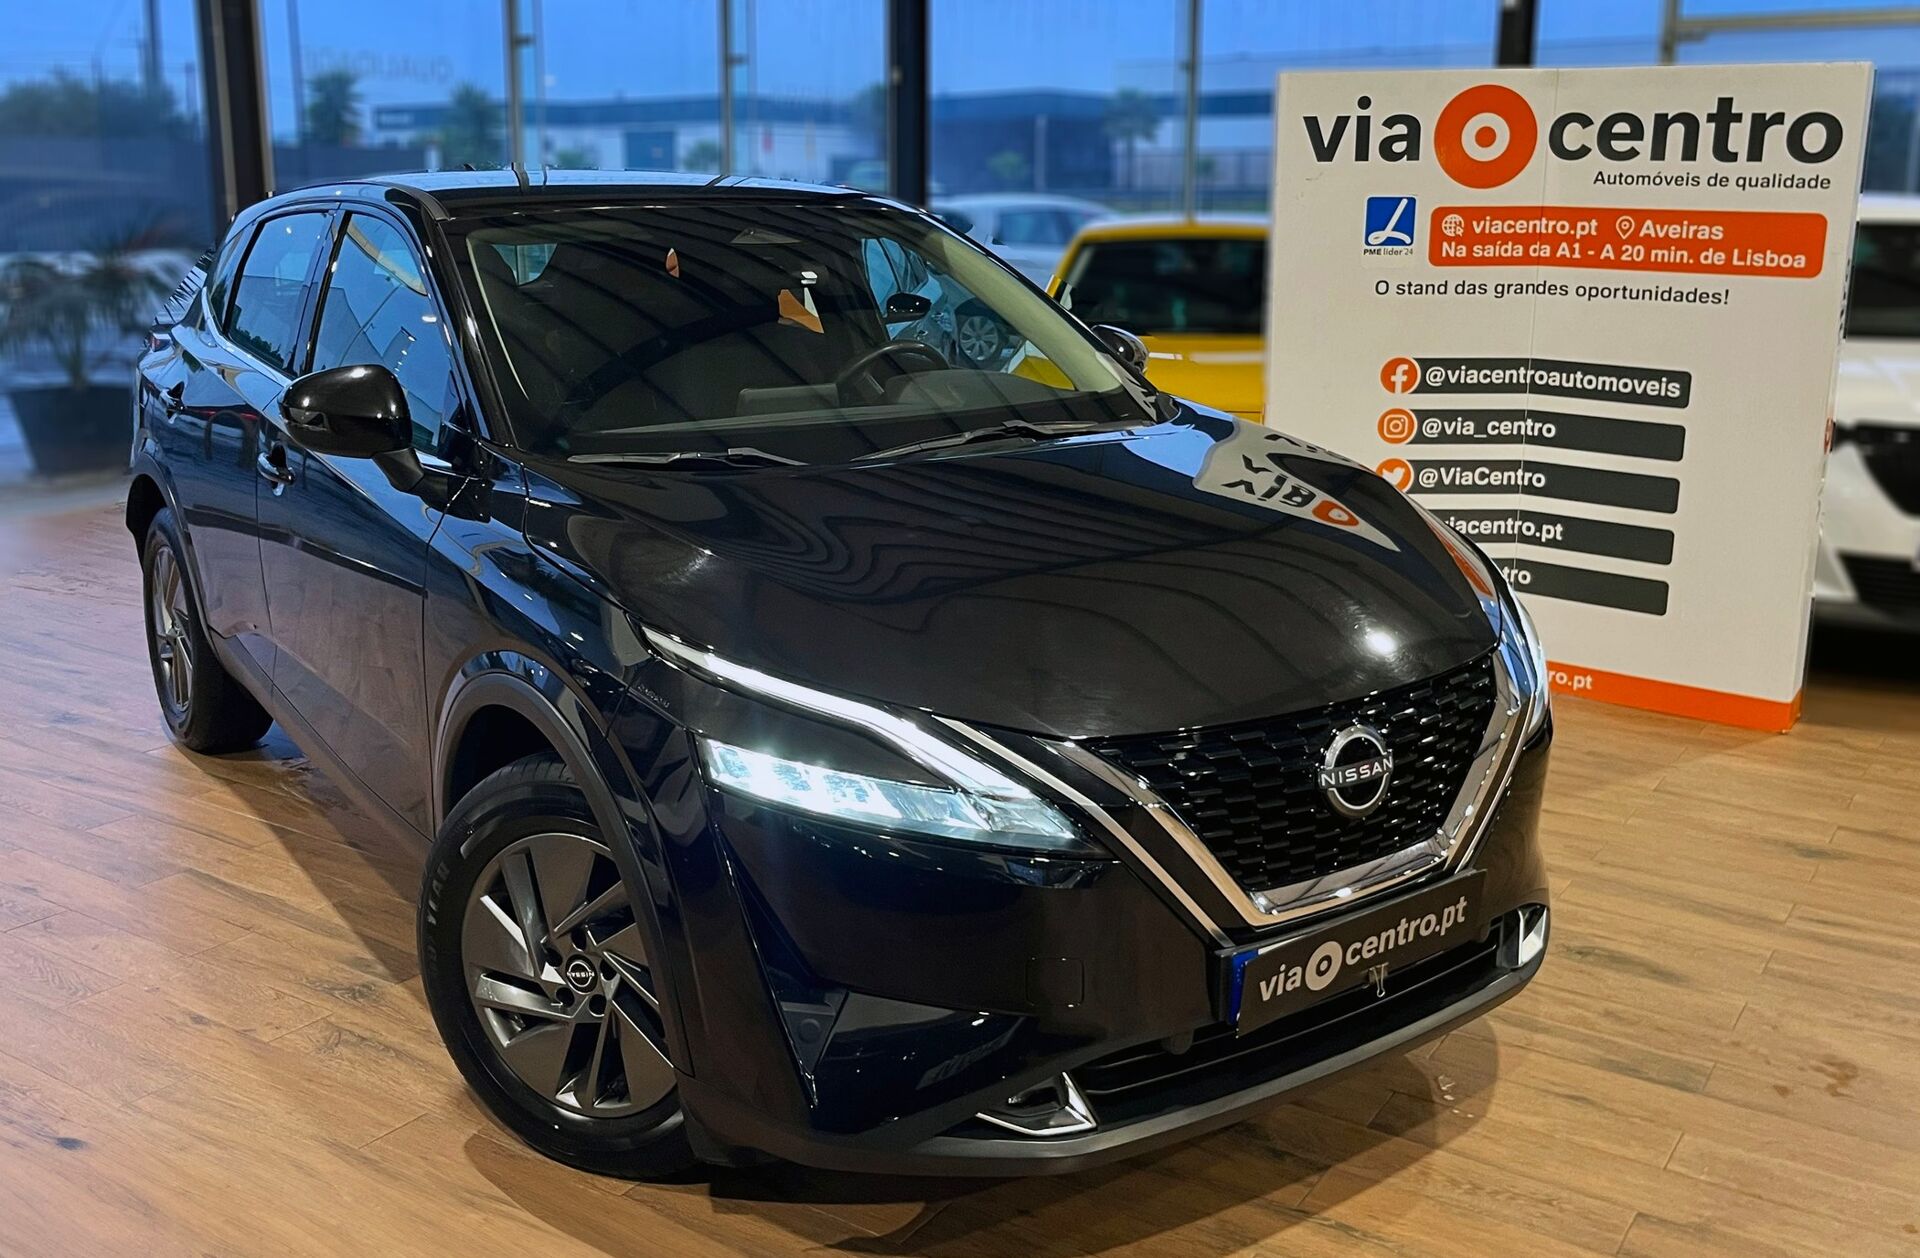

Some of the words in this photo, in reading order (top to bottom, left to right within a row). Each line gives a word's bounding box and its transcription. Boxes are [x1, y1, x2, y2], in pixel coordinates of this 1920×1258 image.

[1303, 95, 1422, 163] via
[1548, 97, 1844, 164] centro
[1593, 171, 1701, 187] Automóveis
[1707, 173, 1730, 188] de
[1735, 173, 1831, 191] qualidade
[1472, 216, 1598, 239] viacentro.pt
[1639, 220, 1724, 240] Aveiras
[1363, 248, 1382, 256] PME
[1441, 241, 1467, 258] Na
[1472, 241, 1524, 258] saída
[1529, 241, 1551, 258] da
[1556, 242, 1582, 259] A1
[1600, 244, 1615, 261] A
[1620, 245, 1645, 262] 20
[1650, 247, 1694, 264] min.
[1699, 248, 1726, 265] de
[1731, 248, 1806, 269] Lisboa
[1375, 280, 1390, 296] O
[1396, 280, 1448, 296] stand
[1454, 280, 1488, 296] das
[1494, 280, 1569, 299] grandes
[1575, 284, 1730, 305] oportunidades!
[1425, 366, 1681, 398] @viacentroautomoveis
[1421, 417, 1557, 440] @via_centro
[1418, 466, 1546, 489] @ViaCentro
[1444, 516, 1563, 542] iacentro.pt
[1320, 755, 1393, 787] NISSAN
[1259, 963, 1303, 1002] via
[1345, 895, 1468, 966] centro.pt
